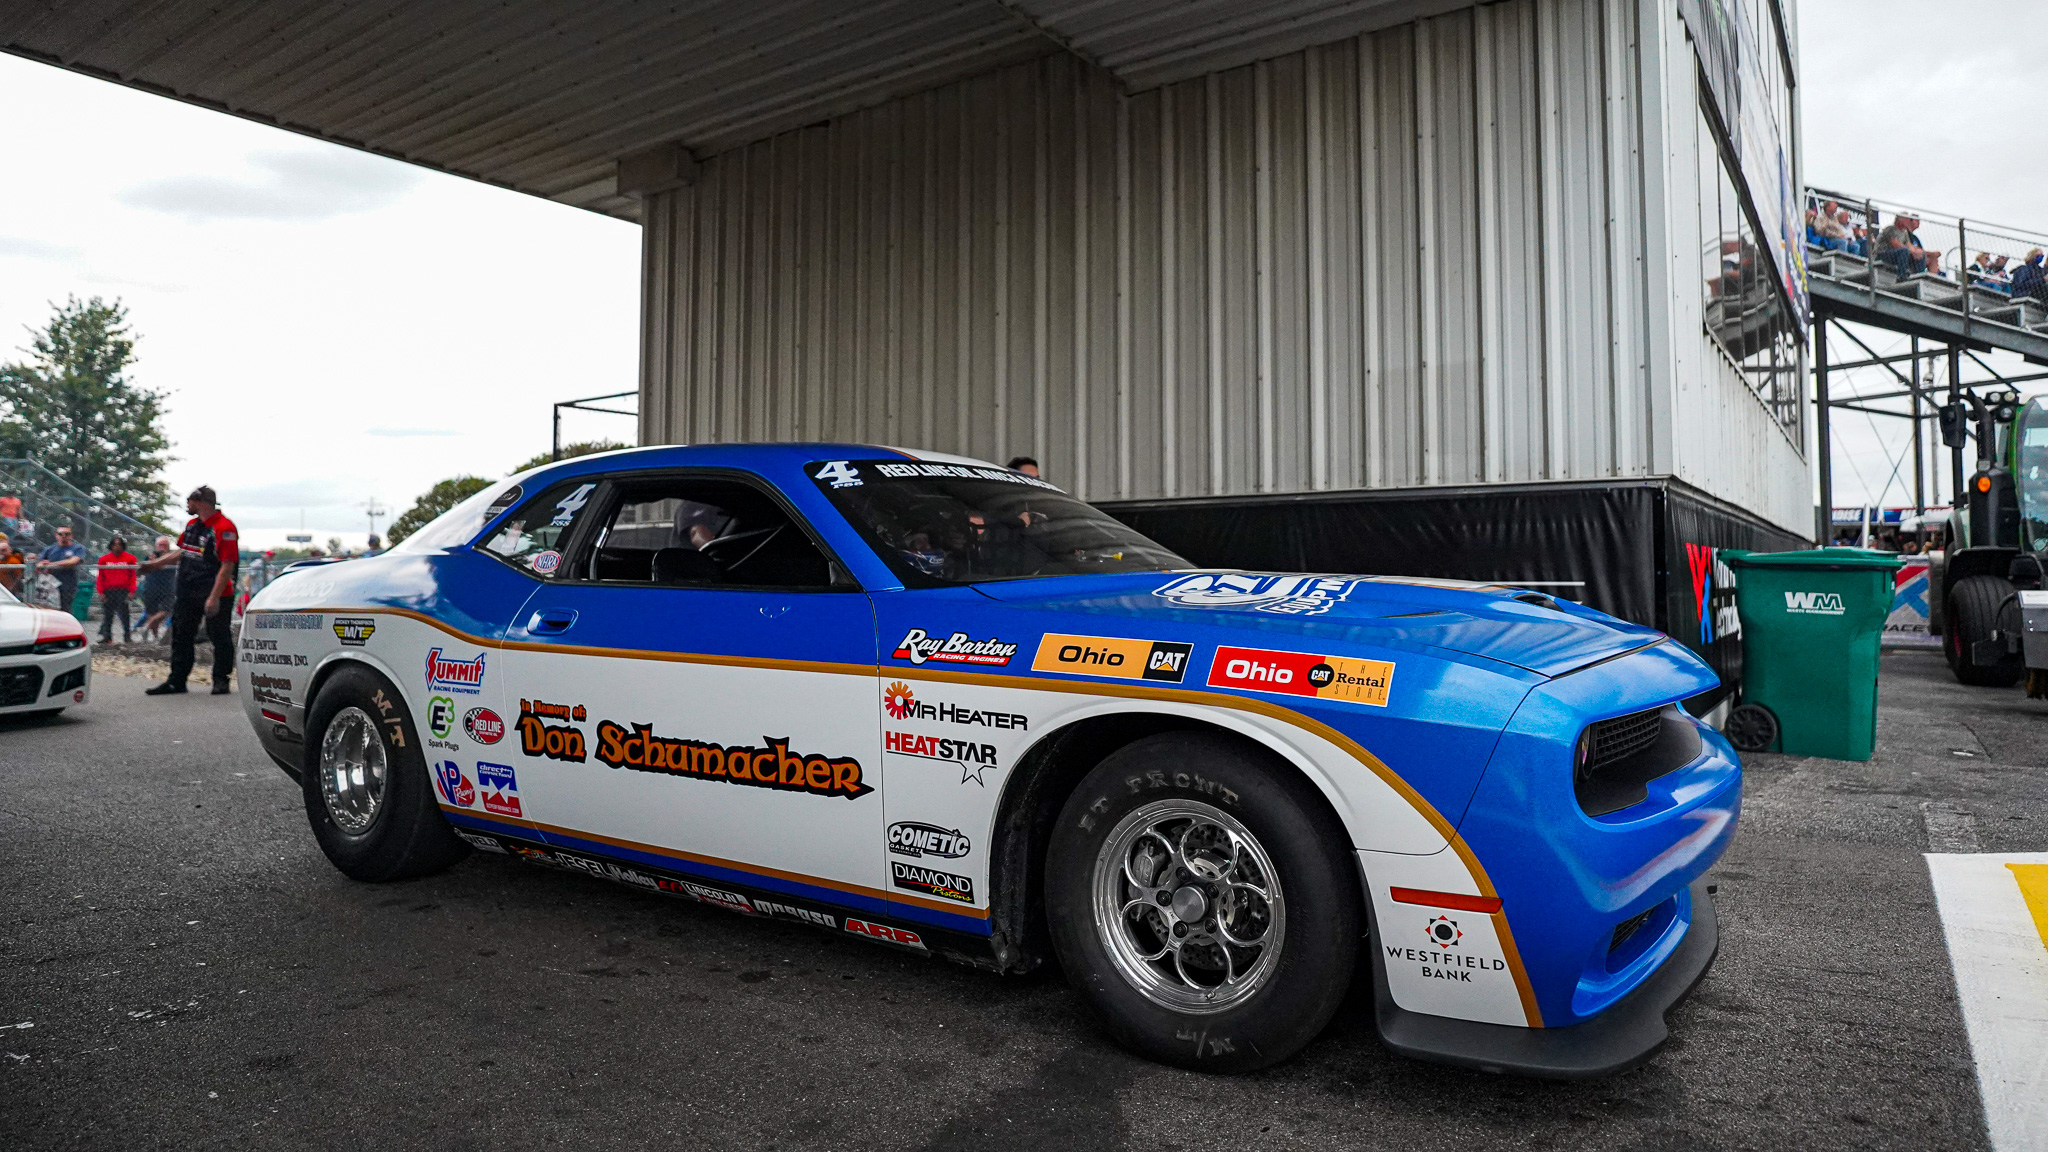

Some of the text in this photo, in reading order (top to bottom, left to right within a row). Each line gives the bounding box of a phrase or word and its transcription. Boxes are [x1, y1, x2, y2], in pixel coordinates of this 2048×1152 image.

[814, 461, 861, 483] 4
[875, 464, 918, 477] RED
[911, 465, 954, 478] LINE
[949, 467, 982, 479] OIL
[556, 484, 597, 520] 4
[538, 555, 558, 569] NHRA
[1784, 592, 1846, 611] WM
[283, 614, 324, 630] CORPORATION
[344, 625, 365, 639] M/T
[897, 628, 1018, 665] Ray Barton
[427, 651, 483, 685] SUMMIT
[932, 653, 1006, 664] RACING ENGINES
[1058, 645, 1186, 672] Ohio CAT
[1338, 661, 1388, 677] THE
[1225, 659, 1331, 684] Ohio CAT
[1335, 672, 1386, 688] Rental
[452, 687, 480, 695] EQUIPMENT
[371, 689, 406, 748] M/T
[520, 699, 587, 720] In Memory of:
[902, 699, 1029, 731] MR HEATER
[474, 718, 502, 733] RED LINE
[428, 739, 460, 752] Spark Plugs
[519, 714, 864, 796] Don Schumacher
[885, 731, 998, 766] HEATSTAR
[435, 759, 462, 806] VP
[455, 787, 474, 802] Racing
[1077, 770, 1240, 833] ET FRONT
[889, 824, 969, 856] COMETIC
[894, 863, 971, 892] DIAMOND
[610, 864, 661, 890] Holley
[685, 883, 739, 904] LINCOLN
[846, 919, 922, 945] ARP
[930, 885, 973, 902] Pistons
[1386, 946, 1505, 971] WESTFIELD
[1422, 966, 1472, 982] BANK
